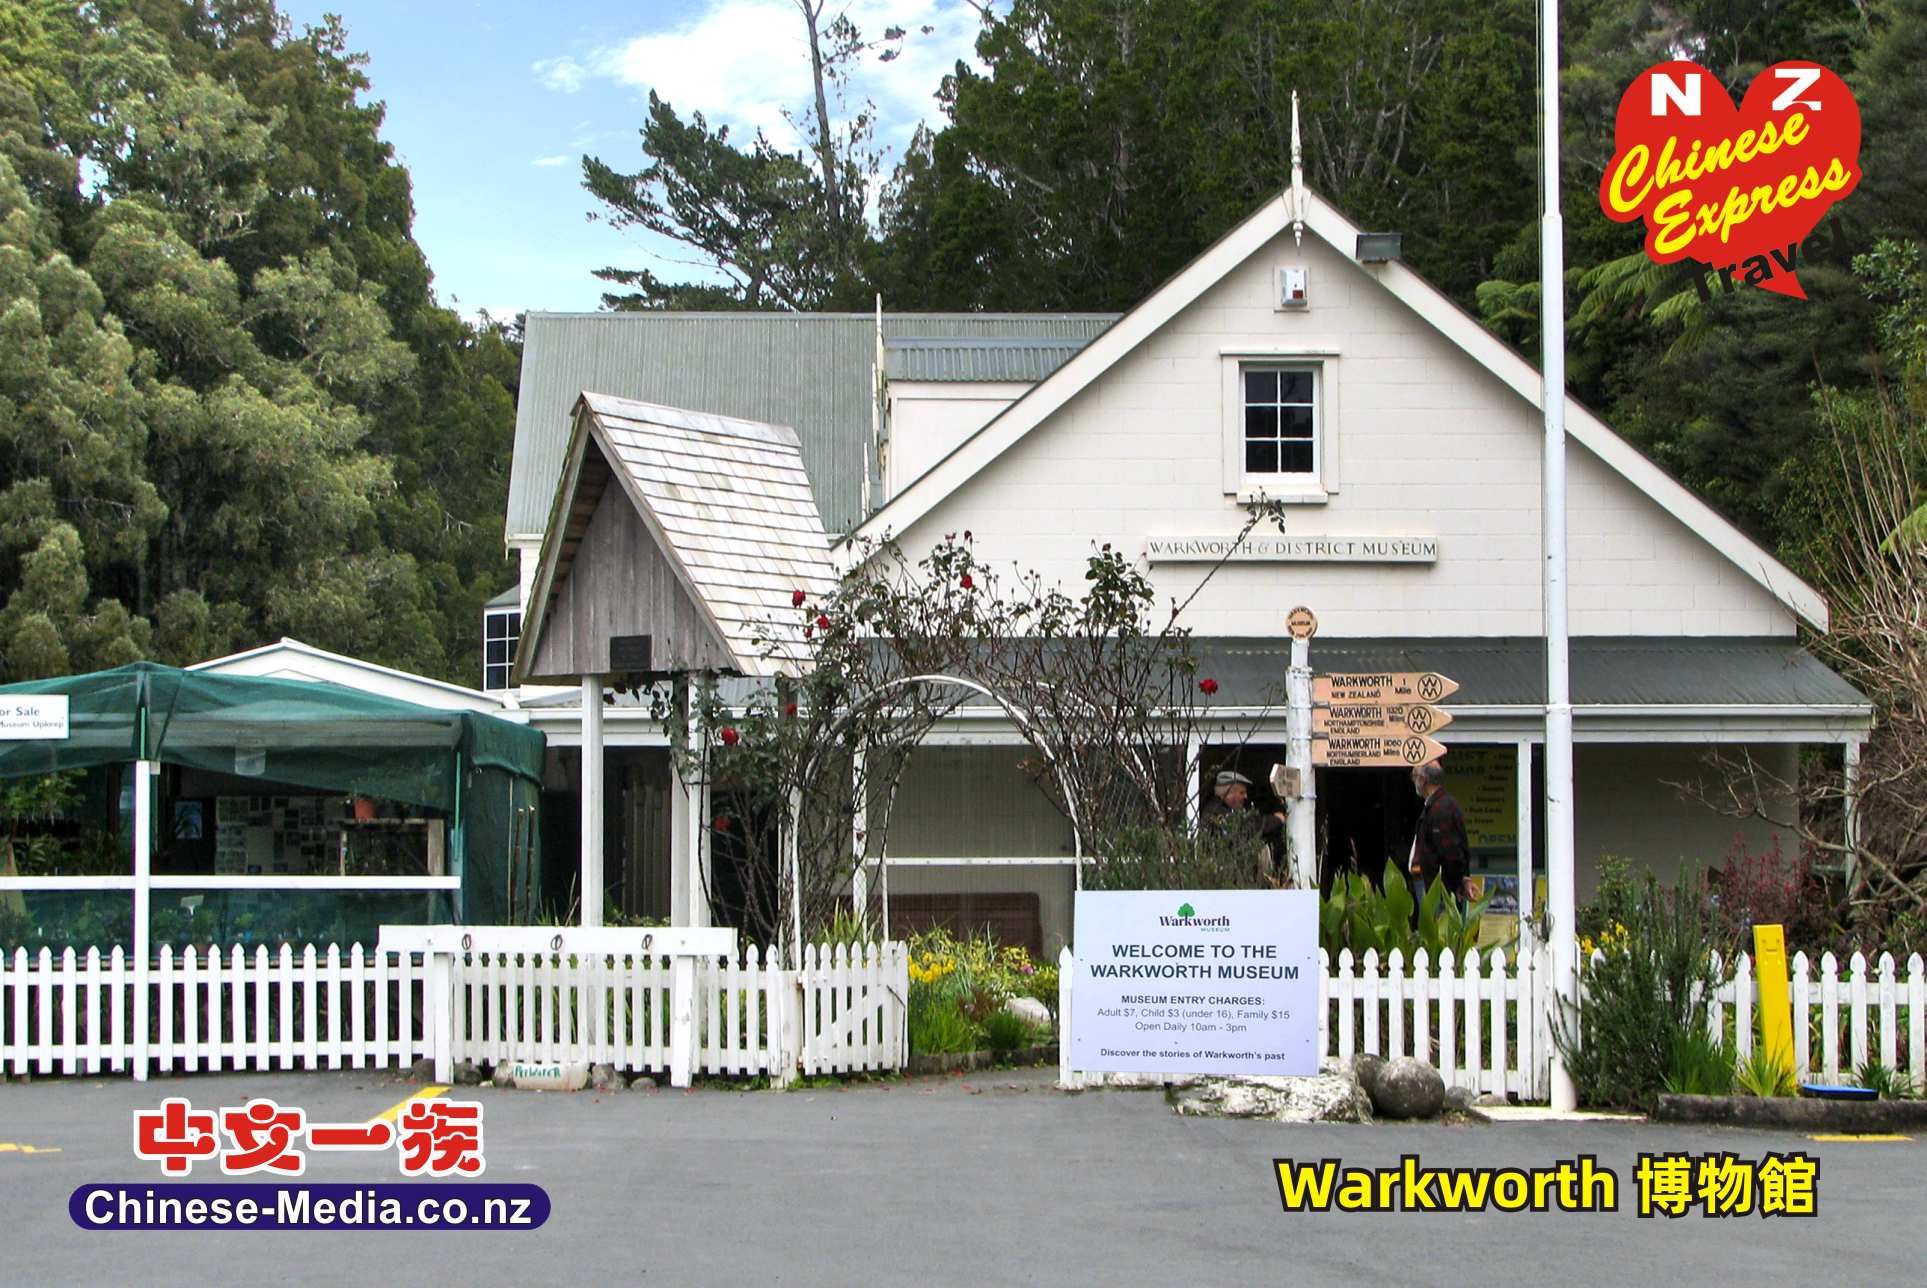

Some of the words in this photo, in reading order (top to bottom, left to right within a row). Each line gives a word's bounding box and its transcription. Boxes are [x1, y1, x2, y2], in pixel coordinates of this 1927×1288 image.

[1150, 541, 1252, 555] WARKWORTH
[1275, 542, 1354, 555] DISTRICT
[1363, 542, 1436, 555] MUSEUM
[1331, 675, 1393, 687] WARKWORTH
[1331, 691, 1346, 699] NEW
[1348, 690, 1381, 699] ZEALAND
[1394, 687, 1412, 695] Mile
[15, 706, 41, 717] Sale
[1330, 706, 1382, 719] WARKWORTH
[1328, 738, 1381, 749] WARKWORTH
[1326, 750, 1382, 758] NORTHUMBERLAND
[1159, 914, 1230, 927] Warkworth
[1112, 944, 1205, 958] WELCOME
[1211, 944, 1235, 959] TO
[1240, 945, 1277, 959] THE
[1090, 965, 1212, 979] WARKWORTH
[1218, 965, 1299, 980] MUSEUM
[1121, 995, 1168, 1004] MUSEUM
[1170, 996, 1206, 1005] ENTRY
[1208, 996, 1265, 1006] CHARGES:
[1097, 1008, 1121, 1017] Adult
[1123, 1008, 1138, 1018] $7,
[1141, 1008, 1165, 1018] Child
[1167, 1008, 1180, 1018] $3
[1182, 1009, 1213, 1019] (under
[1217, 1009, 1234, 1020] 16),
[1237, 1009, 1269, 1021] Family
[1271, 1010, 1290, 1020] $15
[1135, 1021, 1161, 1032] Open
[1163, 1022, 1187, 1032] Daily
[1191, 1022, 1217, 1032] 10am
[1226, 1023, 1247, 1033] 3pm
[1100, 1048, 1140, 1057] Discover
[1159, 1050, 1190, 1058] stories
[1193, 1050, 1202, 1058] of
[1204, 1050, 1262, 1060] Warkworth's
[1264, 1052, 1285, 1061] past
